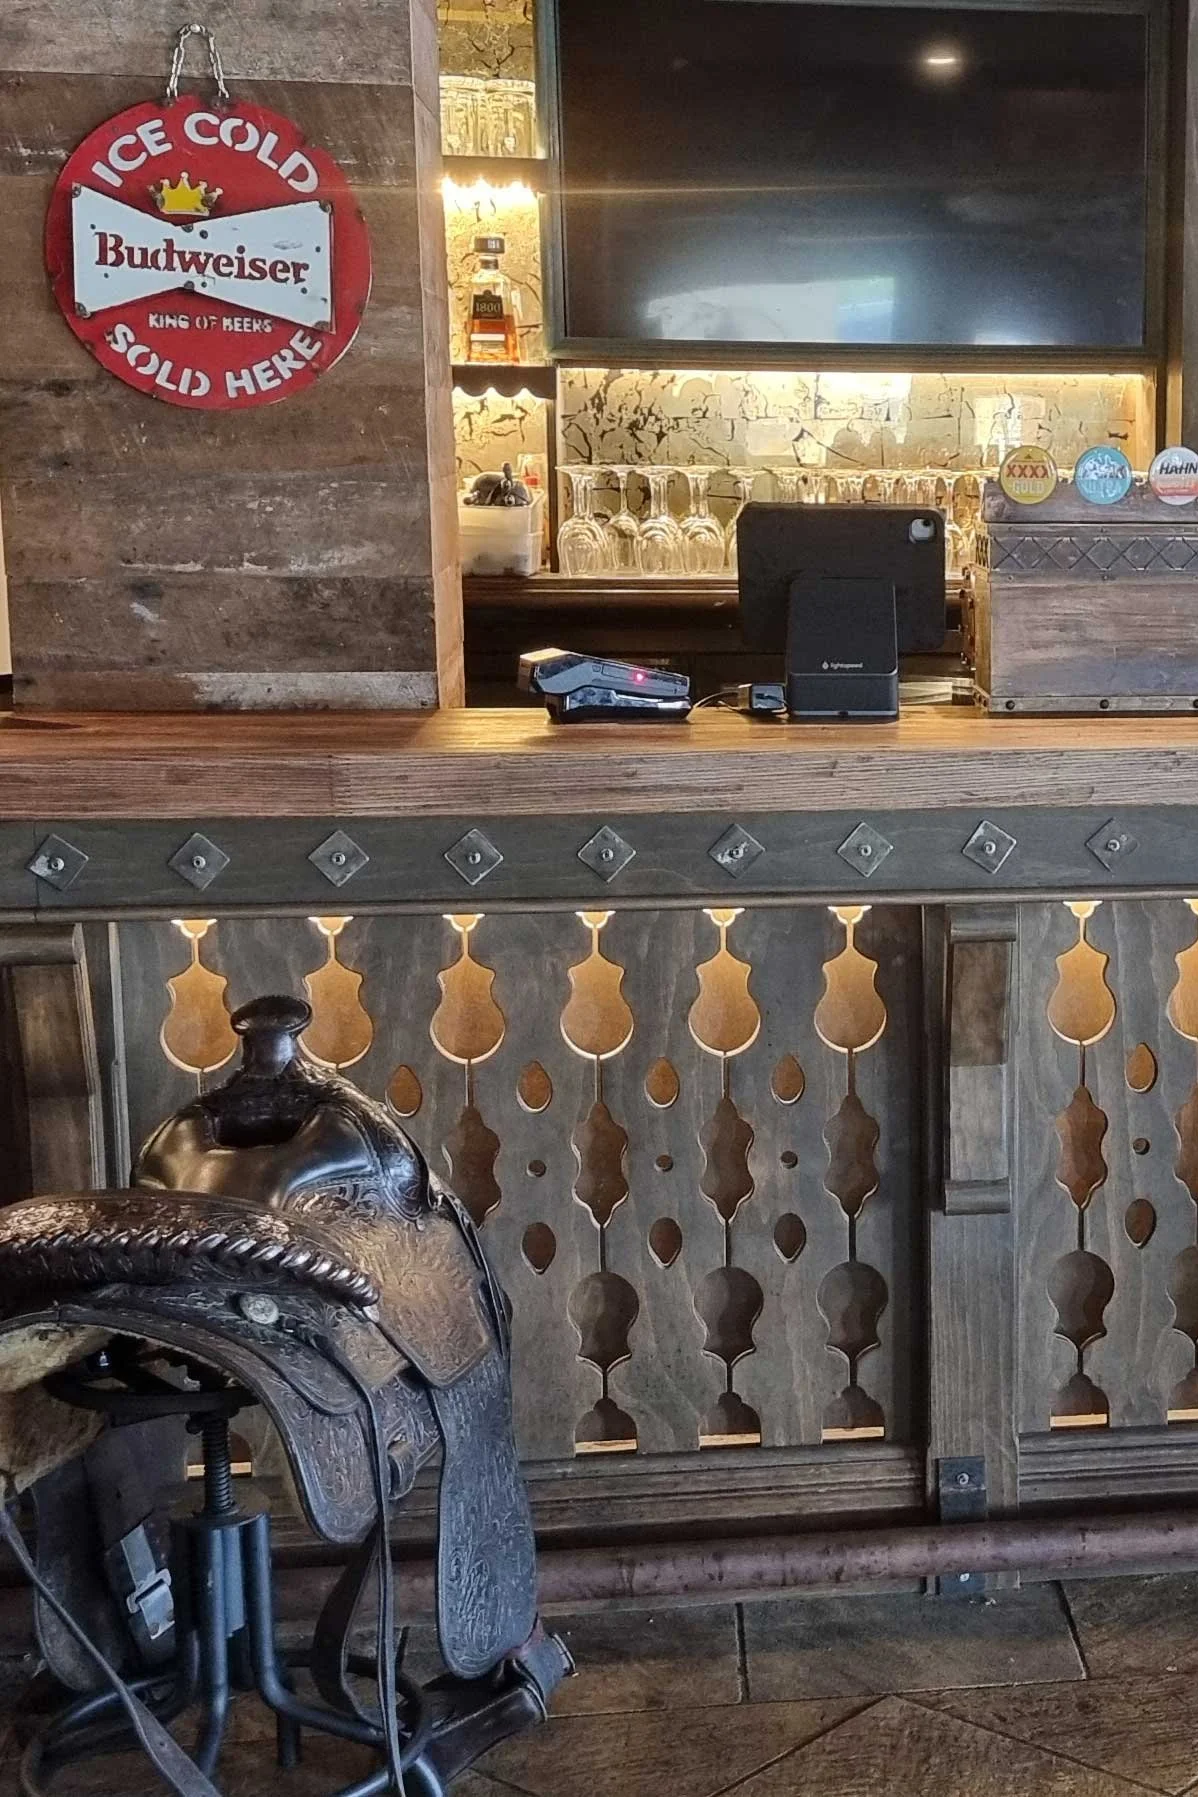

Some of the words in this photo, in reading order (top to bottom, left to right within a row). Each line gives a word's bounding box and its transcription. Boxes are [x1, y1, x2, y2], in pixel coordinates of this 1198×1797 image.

[91, 118, 173, 188] ICE
[183, 111, 319, 193] COLD
[94, 231, 310, 285] Budweiser
[475, 301, 500, 313] 1800
[148, 313, 190, 330] KING
[195, 315, 218, 330] OF
[222, 316, 274, 334] BEERS
[108, 323, 211, 397] SOLD
[225, 329, 324, 399] HERE
[1005, 464, 1049, 479] XXXX
[1159, 461, 1198, 475] HAHN
